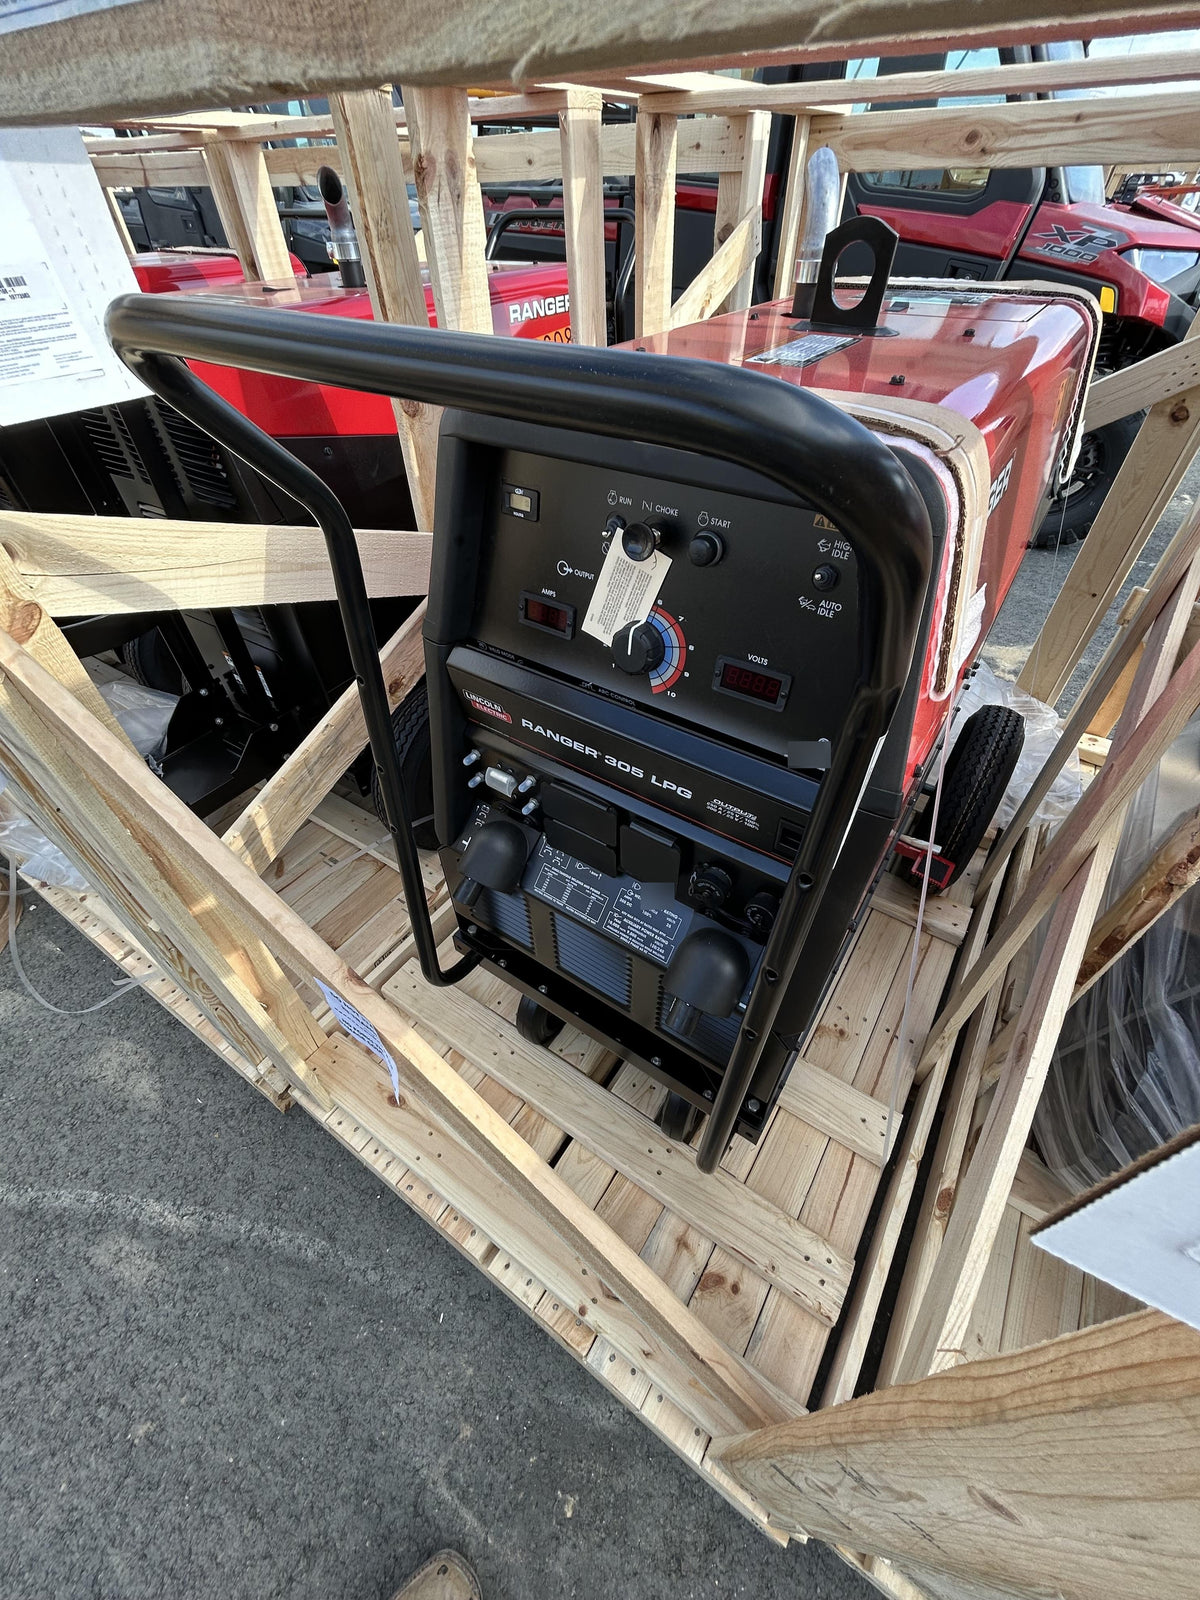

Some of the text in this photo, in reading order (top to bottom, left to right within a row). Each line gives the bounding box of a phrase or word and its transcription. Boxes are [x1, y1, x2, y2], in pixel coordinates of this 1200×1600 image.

[1032, 223, 1118, 249] XP
[1042, 242, 1099, 262] 1000
[619, 495, 633, 506] RUN
[655, 504, 679, 517] CHOKE
[710, 517, 732, 529] START
[833, 539, 853, 552] HIG
[831, 549, 851, 560] IDLE
[574, 568, 595, 581] OUTPUT
[541, 587, 557, 598] AMPS
[819, 599, 843, 612] AUTO
[816, 607, 835, 619] IDLE
[747, 653, 769, 666] VOLTS
[667, 690, 677, 698] 10
[465, 690, 502, 713] LINCOLN
[475, 702, 509, 722] ELECTRIC
[604, 754, 645, 780] 305
[650, 774, 693, 800] LPG
